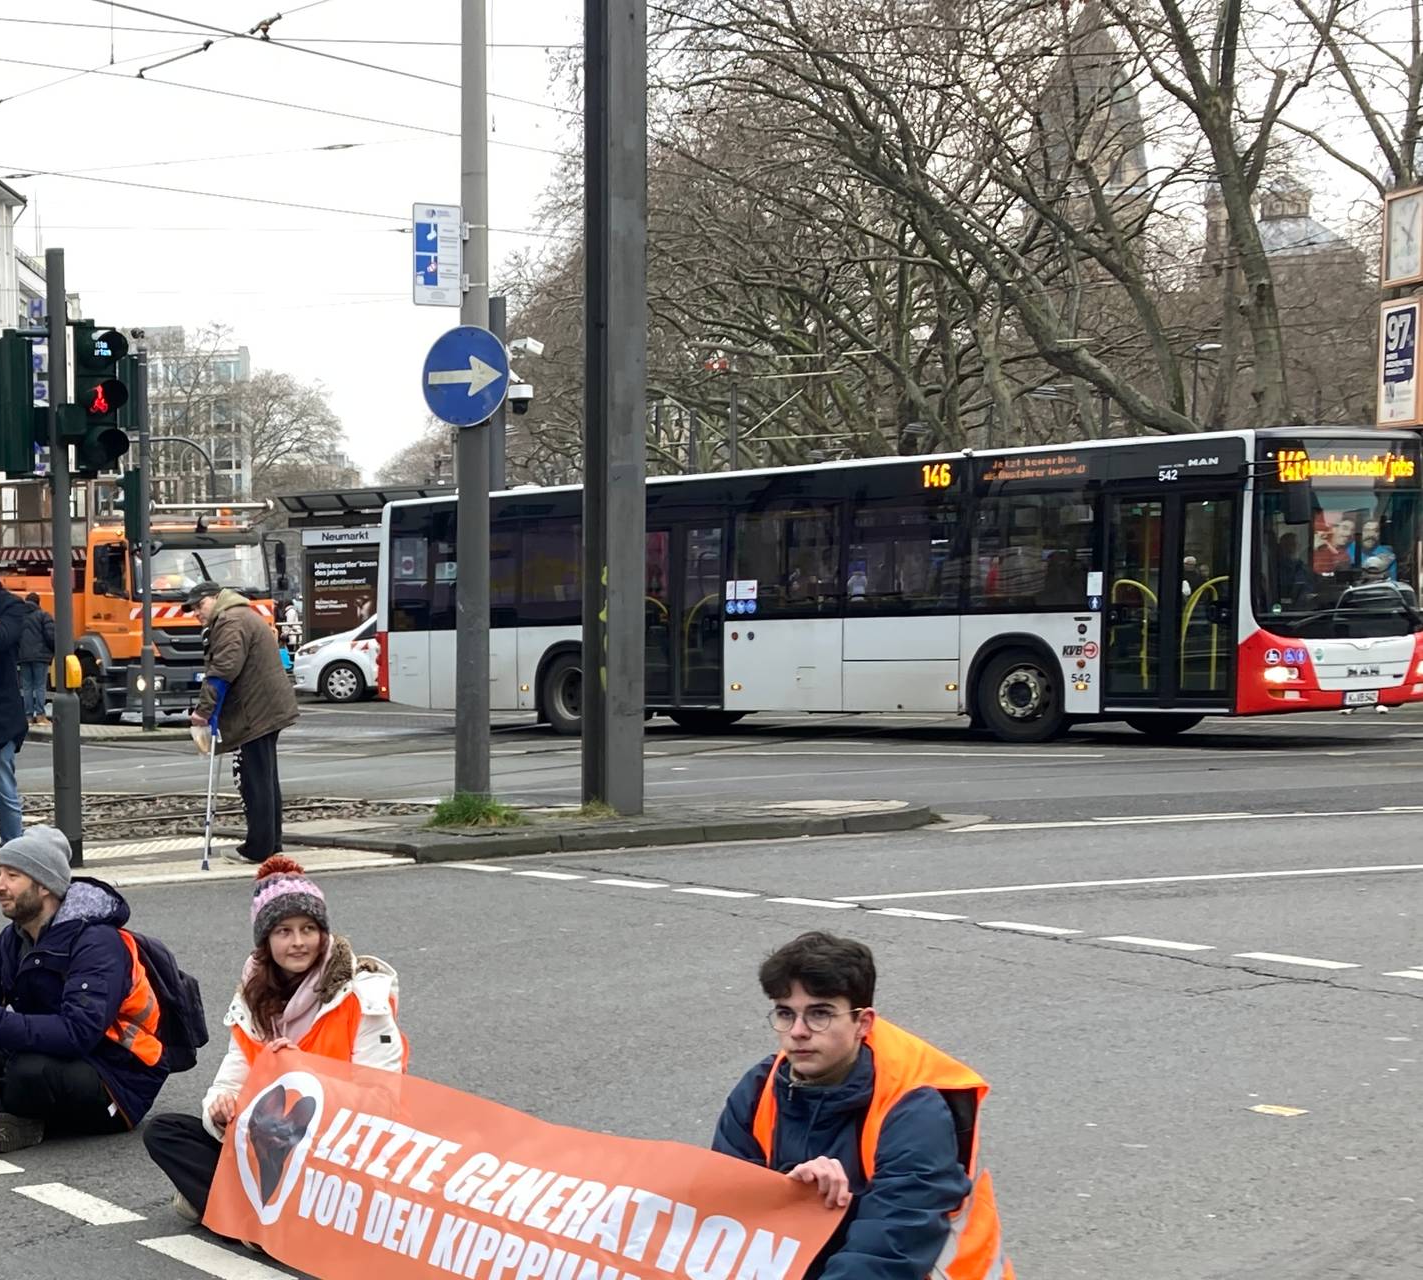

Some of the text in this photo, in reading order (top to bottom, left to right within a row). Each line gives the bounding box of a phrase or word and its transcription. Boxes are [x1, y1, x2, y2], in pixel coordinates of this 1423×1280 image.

[1024, 455, 1077, 467] bewerben
[1187, 456, 1219, 467] MAN
[922, 463, 952, 488] 146
[1158, 469, 1178, 482] 542
[321, 530, 370, 541] Neumarkt
[1062, 645, 1083, 656] KVB
[1072, 674, 1091, 683] 542
[313, 1107, 801, 1280] LETZTE GENERATION
[297, 1167, 363, 1236] VOR
[363, 1190, 435, 1260] DEN
